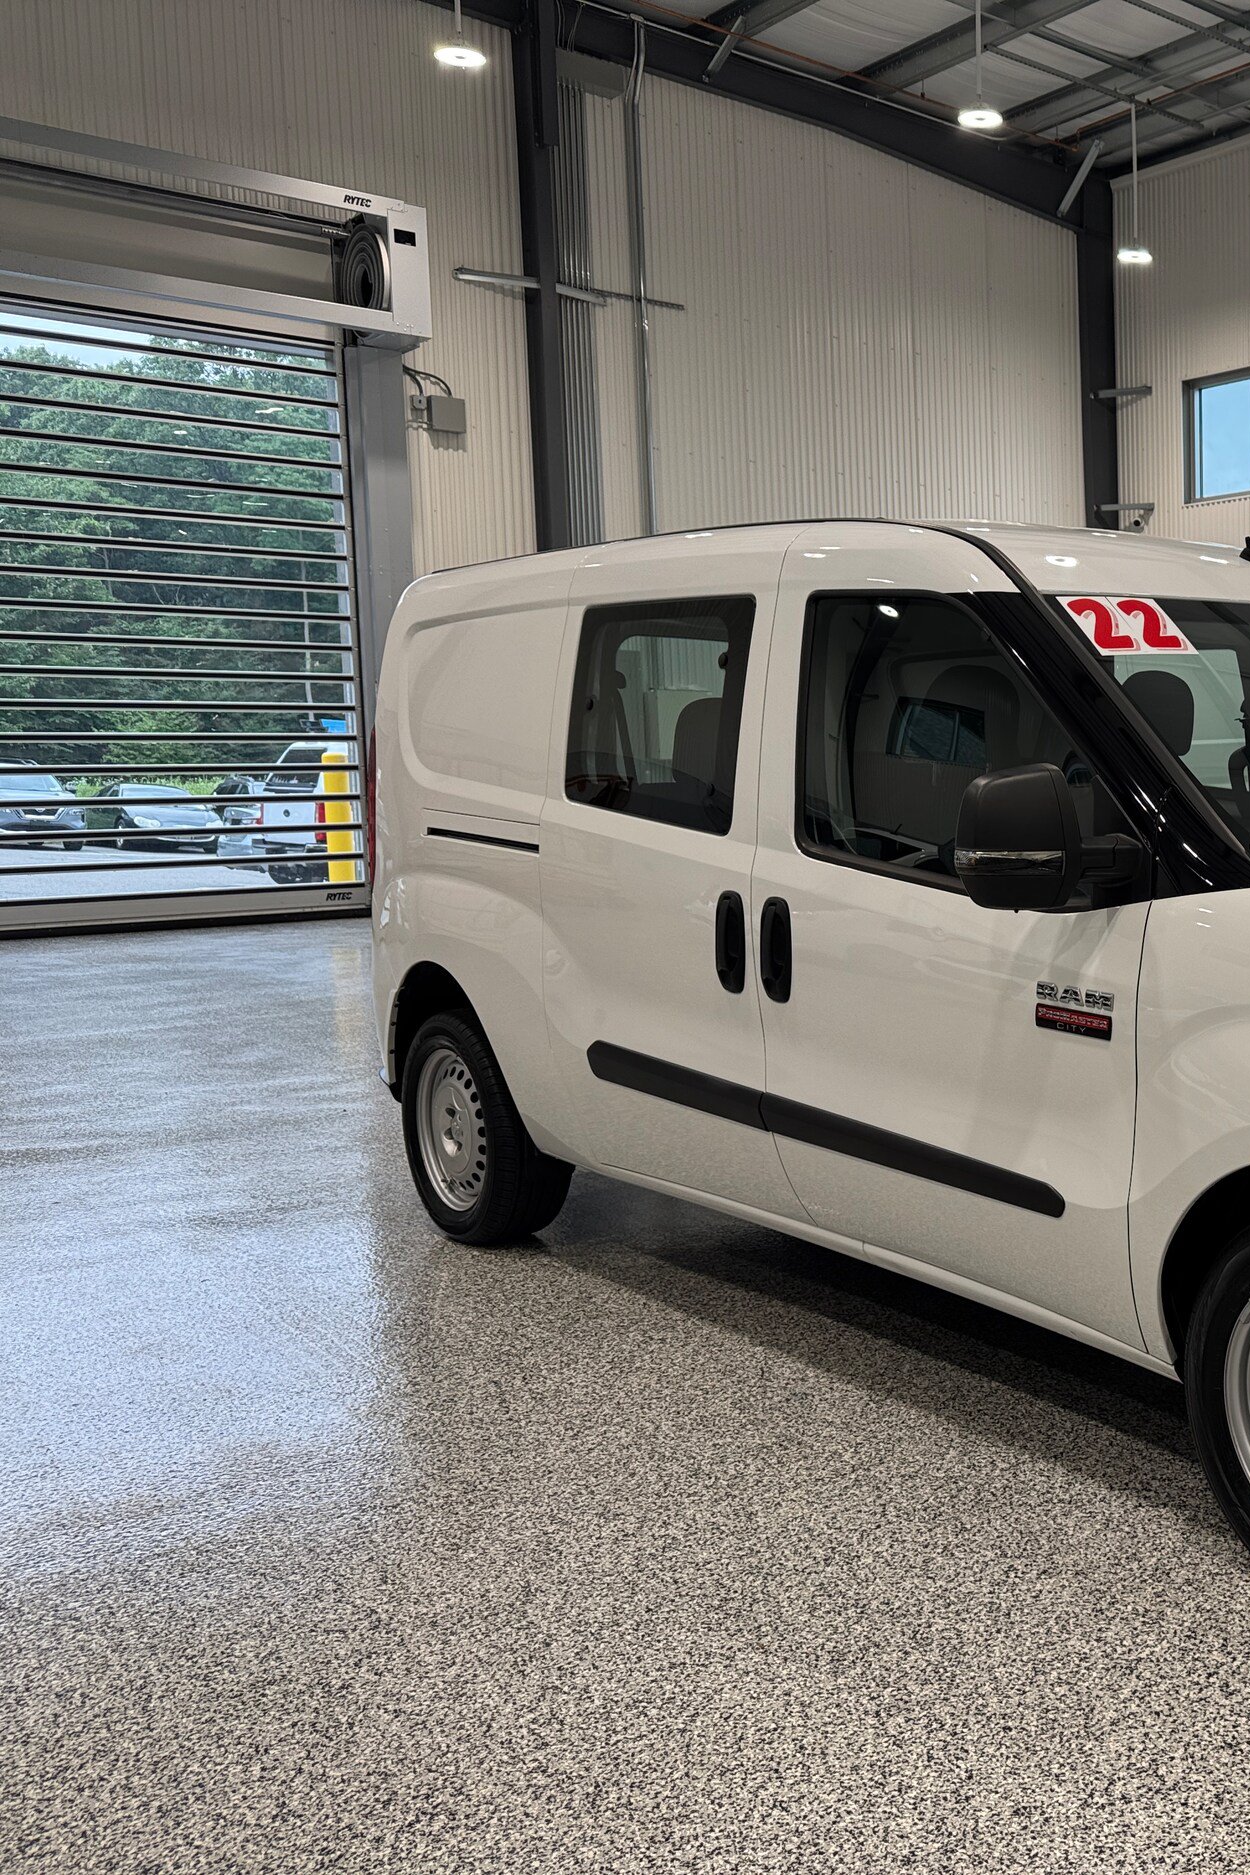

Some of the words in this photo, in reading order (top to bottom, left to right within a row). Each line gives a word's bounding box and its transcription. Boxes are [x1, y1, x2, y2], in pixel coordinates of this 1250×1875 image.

[343, 194, 372, 208] RYTEC
[1066, 598, 1188, 651] 22
[326, 891, 352, 901] RYTEC
[1036, 981, 1114, 1012] RAM
[1056, 1021, 1086, 1033] CITY
